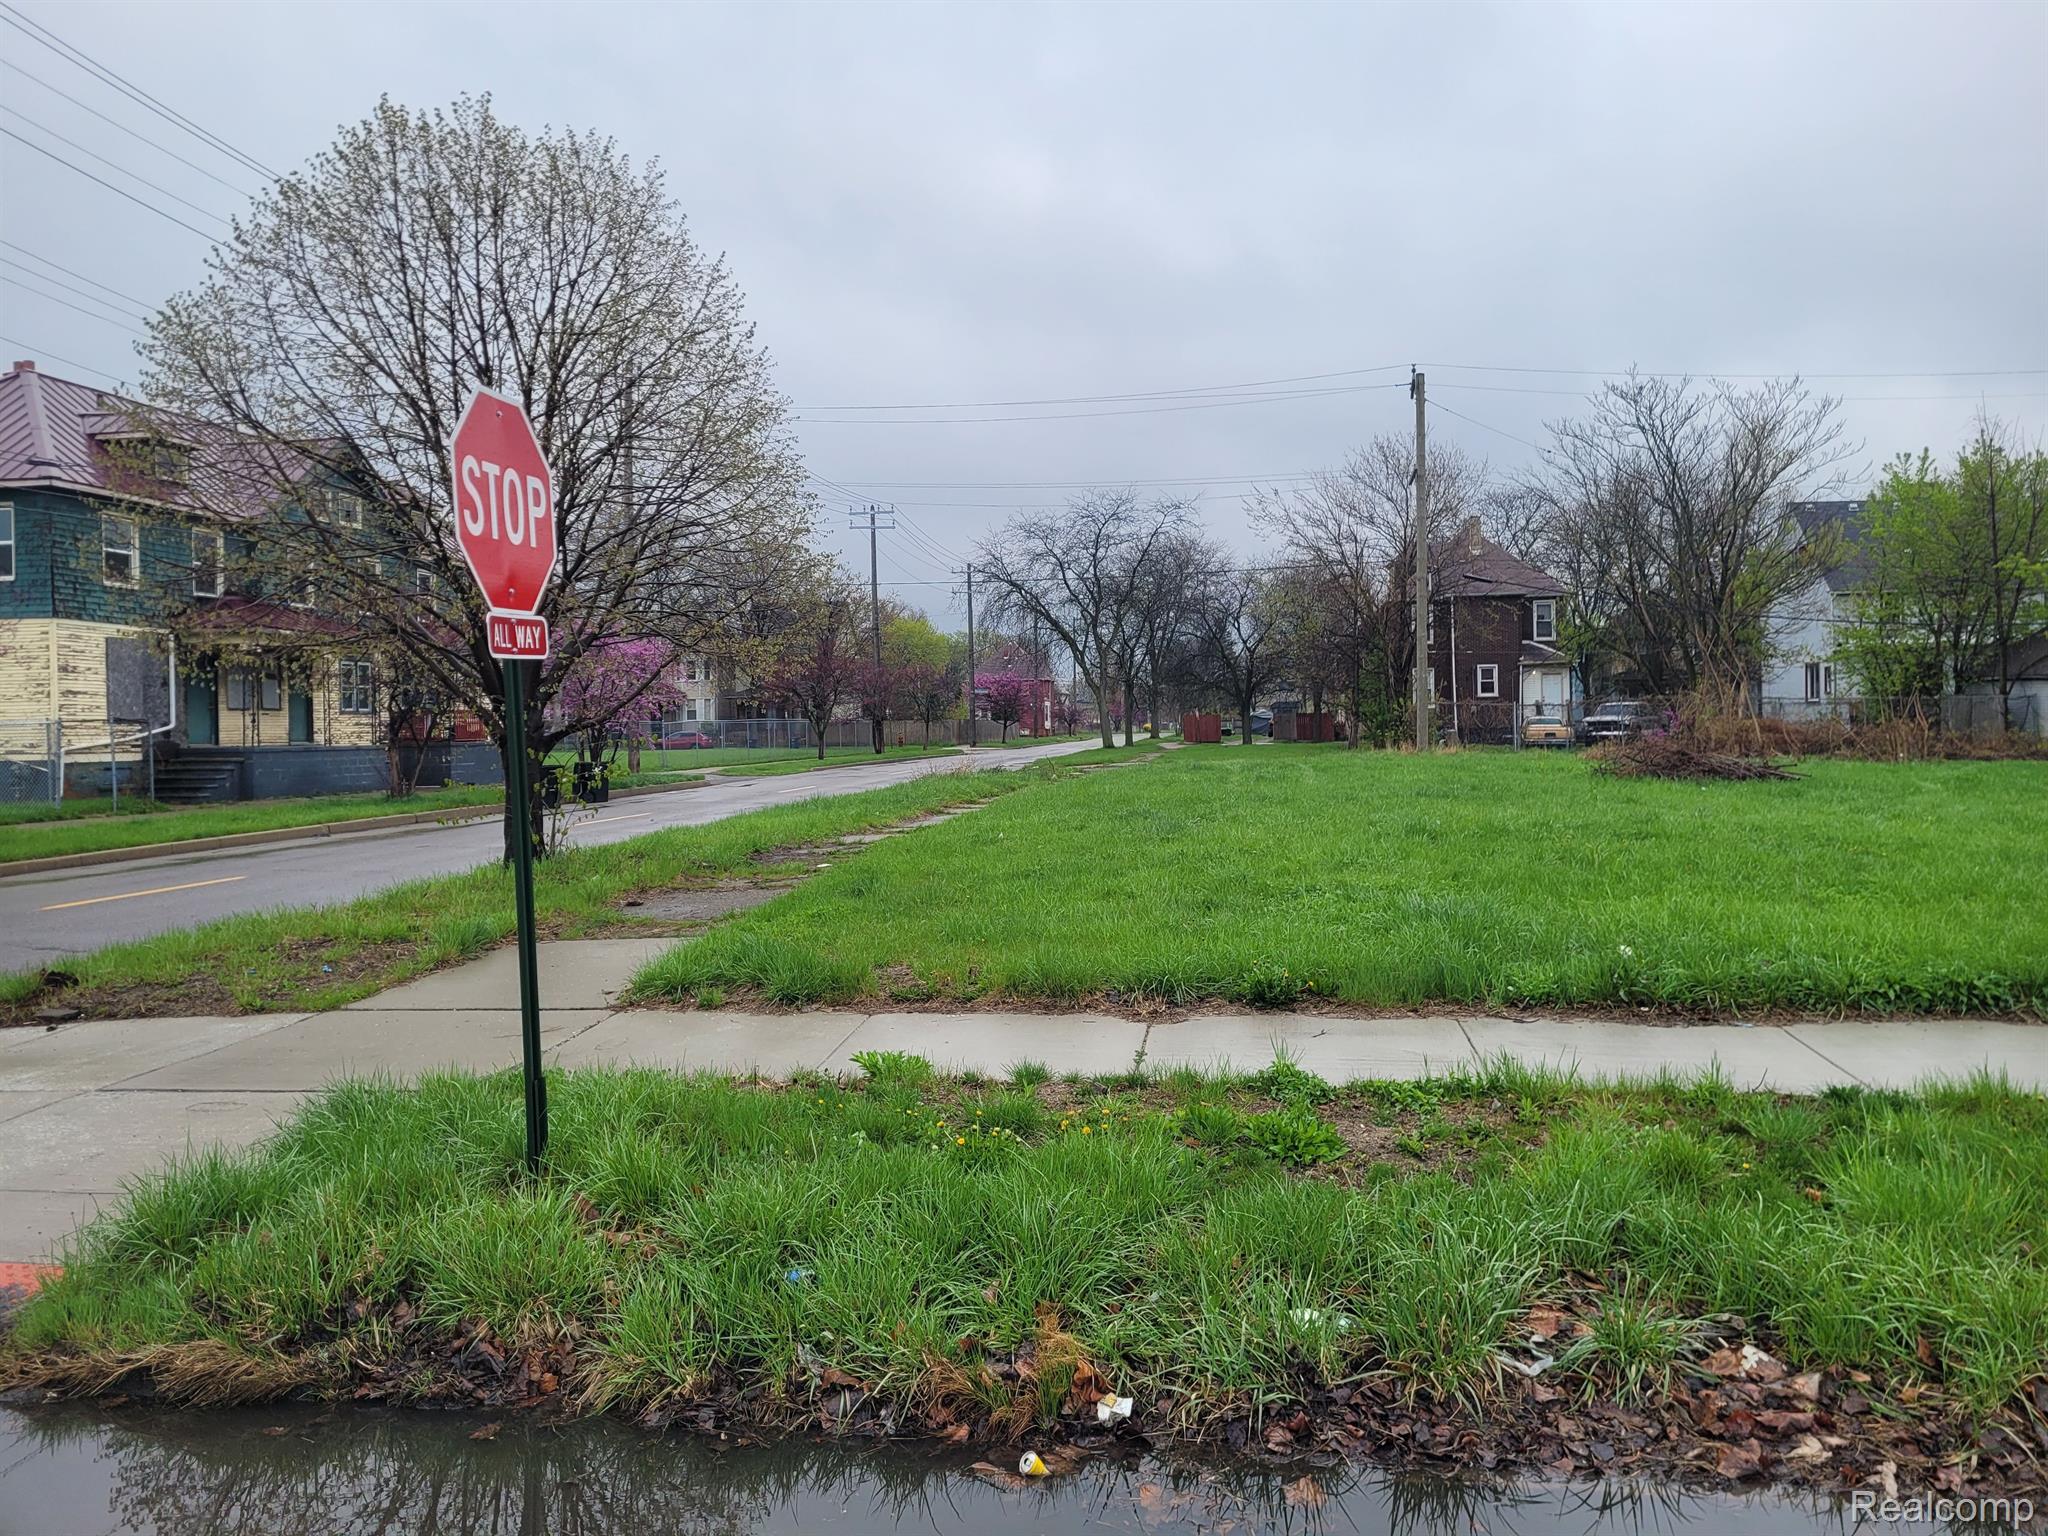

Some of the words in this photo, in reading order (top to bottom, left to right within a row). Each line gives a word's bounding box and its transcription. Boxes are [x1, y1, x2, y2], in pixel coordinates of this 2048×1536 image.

[462, 455, 546, 548] STOP
[494, 623, 512, 648] ALL
[515, 625, 540, 649] WAY
